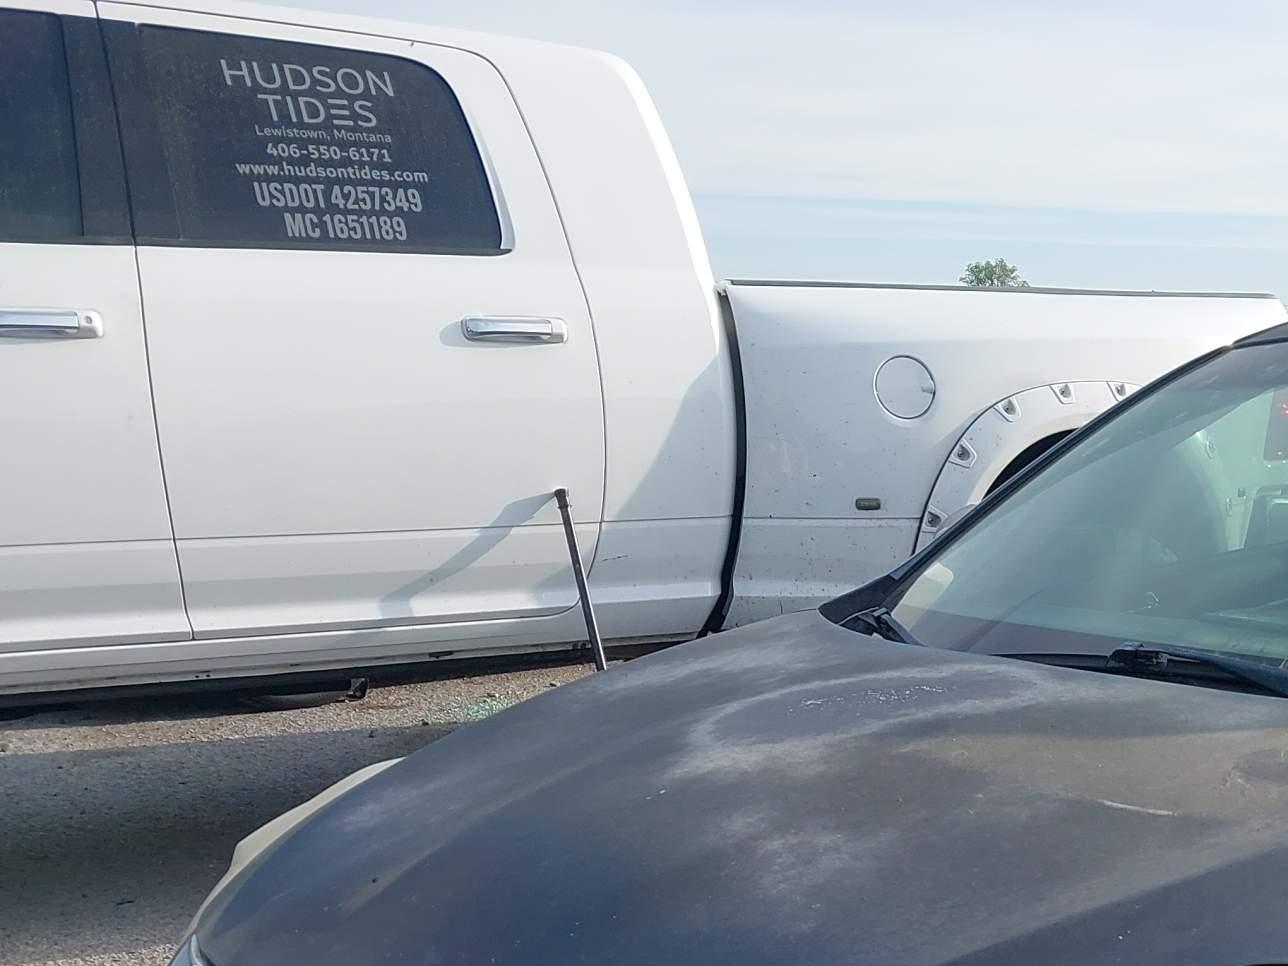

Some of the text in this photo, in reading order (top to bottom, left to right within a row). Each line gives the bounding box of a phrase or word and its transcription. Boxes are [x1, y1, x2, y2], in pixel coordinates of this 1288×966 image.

[219, 59, 395, 97] HUDSON
[257, 93, 377, 127] TIDES
[254, 125, 392, 143] Lewistown, Montana
[266, 143, 392, 162] 406-550-6171
[235, 161, 429, 183] www.hudsontides.com
[253, 182, 423, 212] USDOT 4257349
[283, 212, 407, 241] MC 1651189
